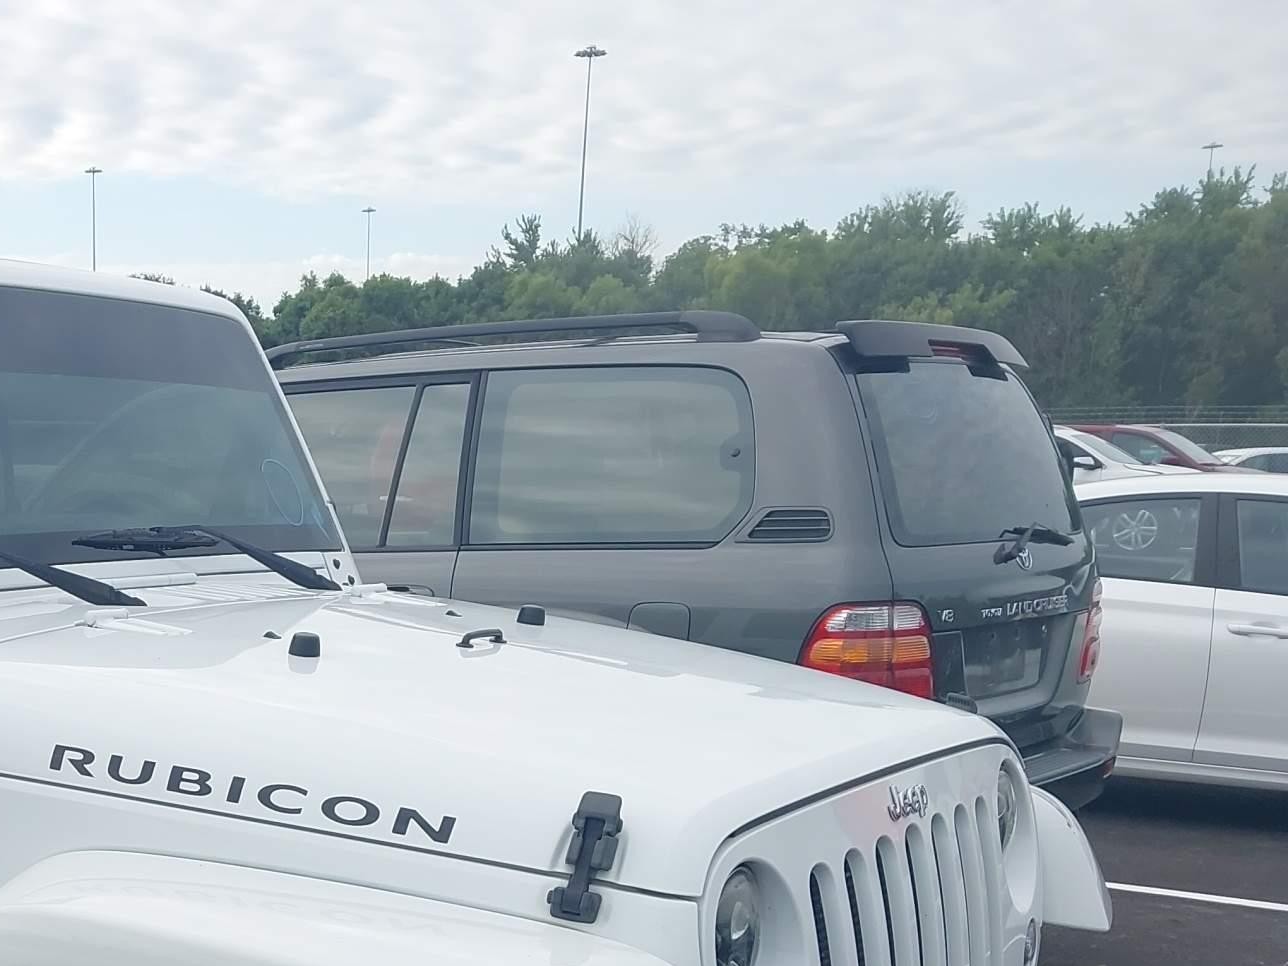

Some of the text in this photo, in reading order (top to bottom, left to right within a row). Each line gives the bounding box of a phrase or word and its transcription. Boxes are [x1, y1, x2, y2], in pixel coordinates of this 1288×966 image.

[1006, 601, 1032, 616] LAND
[1033, 595, 1068, 609] CRUISER
[48, 744, 457, 844] RUBICON
[888, 784, 929, 821] Jeep
